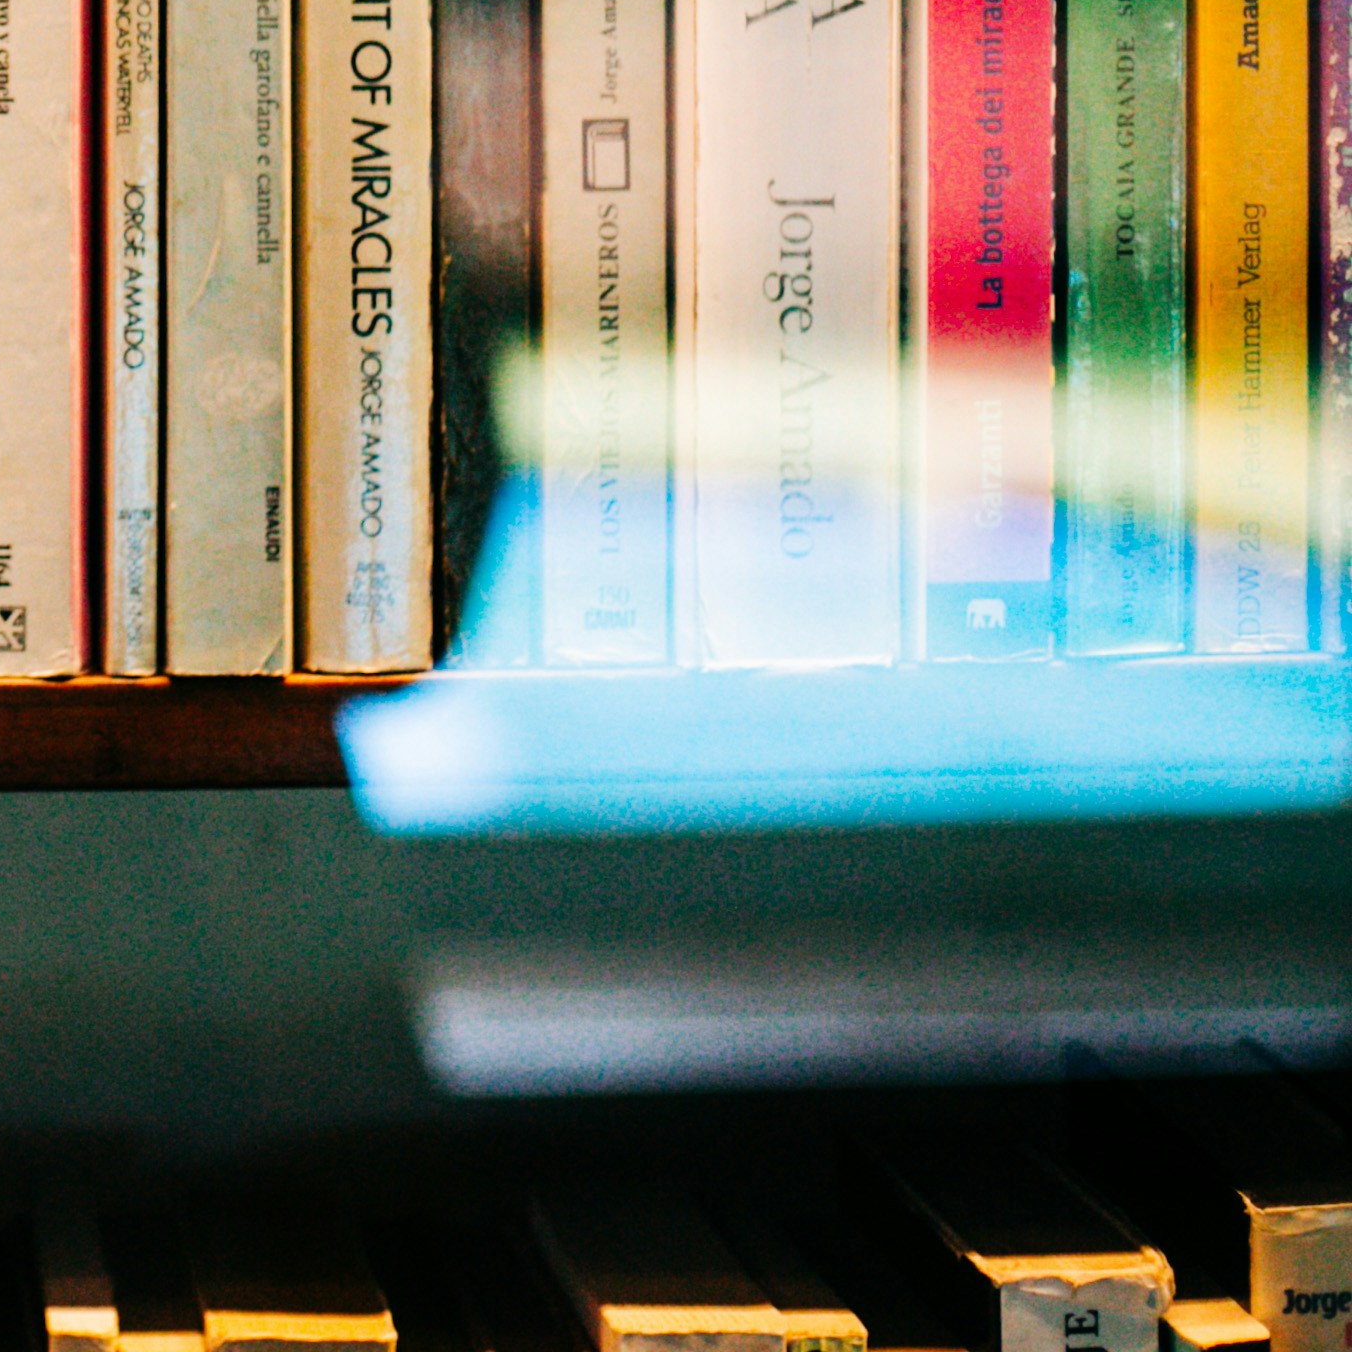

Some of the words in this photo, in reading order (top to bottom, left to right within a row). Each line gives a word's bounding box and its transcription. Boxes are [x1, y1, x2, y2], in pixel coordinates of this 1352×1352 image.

[137, 21, 153, 83] DEATHS
[250, 48, 280, 146] garofano
[349, 39, 393, 105] OF
[600, 46, 620, 103] Jorge
[1116, 37, 1137, 151] GRANDE
[978, 88, 1006, 138] dei
[123, 181, 145, 257] JORGE
[256, 170, 280, 266] cannella
[350, 116, 394, 339] MIRACLES
[762, 178, 837, 336] Jorge
[979, 151, 1011, 272] bottega
[1115, 159, 1137, 262] TOCAIA
[1236, 200, 1267, 289] Verlag
[123, 266, 146, 371] AMADO
[597, 203, 621, 379] MARINEROS
[976, 277, 1004, 311] La
[360, 346, 383, 427] JORGE
[1237, 296, 1263, 416] Hammer
[359, 432, 383, 539] AMADO
[778, 350, 837, 560] Amado
[974, 399, 1003, 530] Garzanti
[1237, 424, 1262, 490] Peter
[264, 485, 281, 563] EINAUDI
[1236, 565, 1262, 638] DDW
[1282, 1288, 1352, 1320] Jorge
